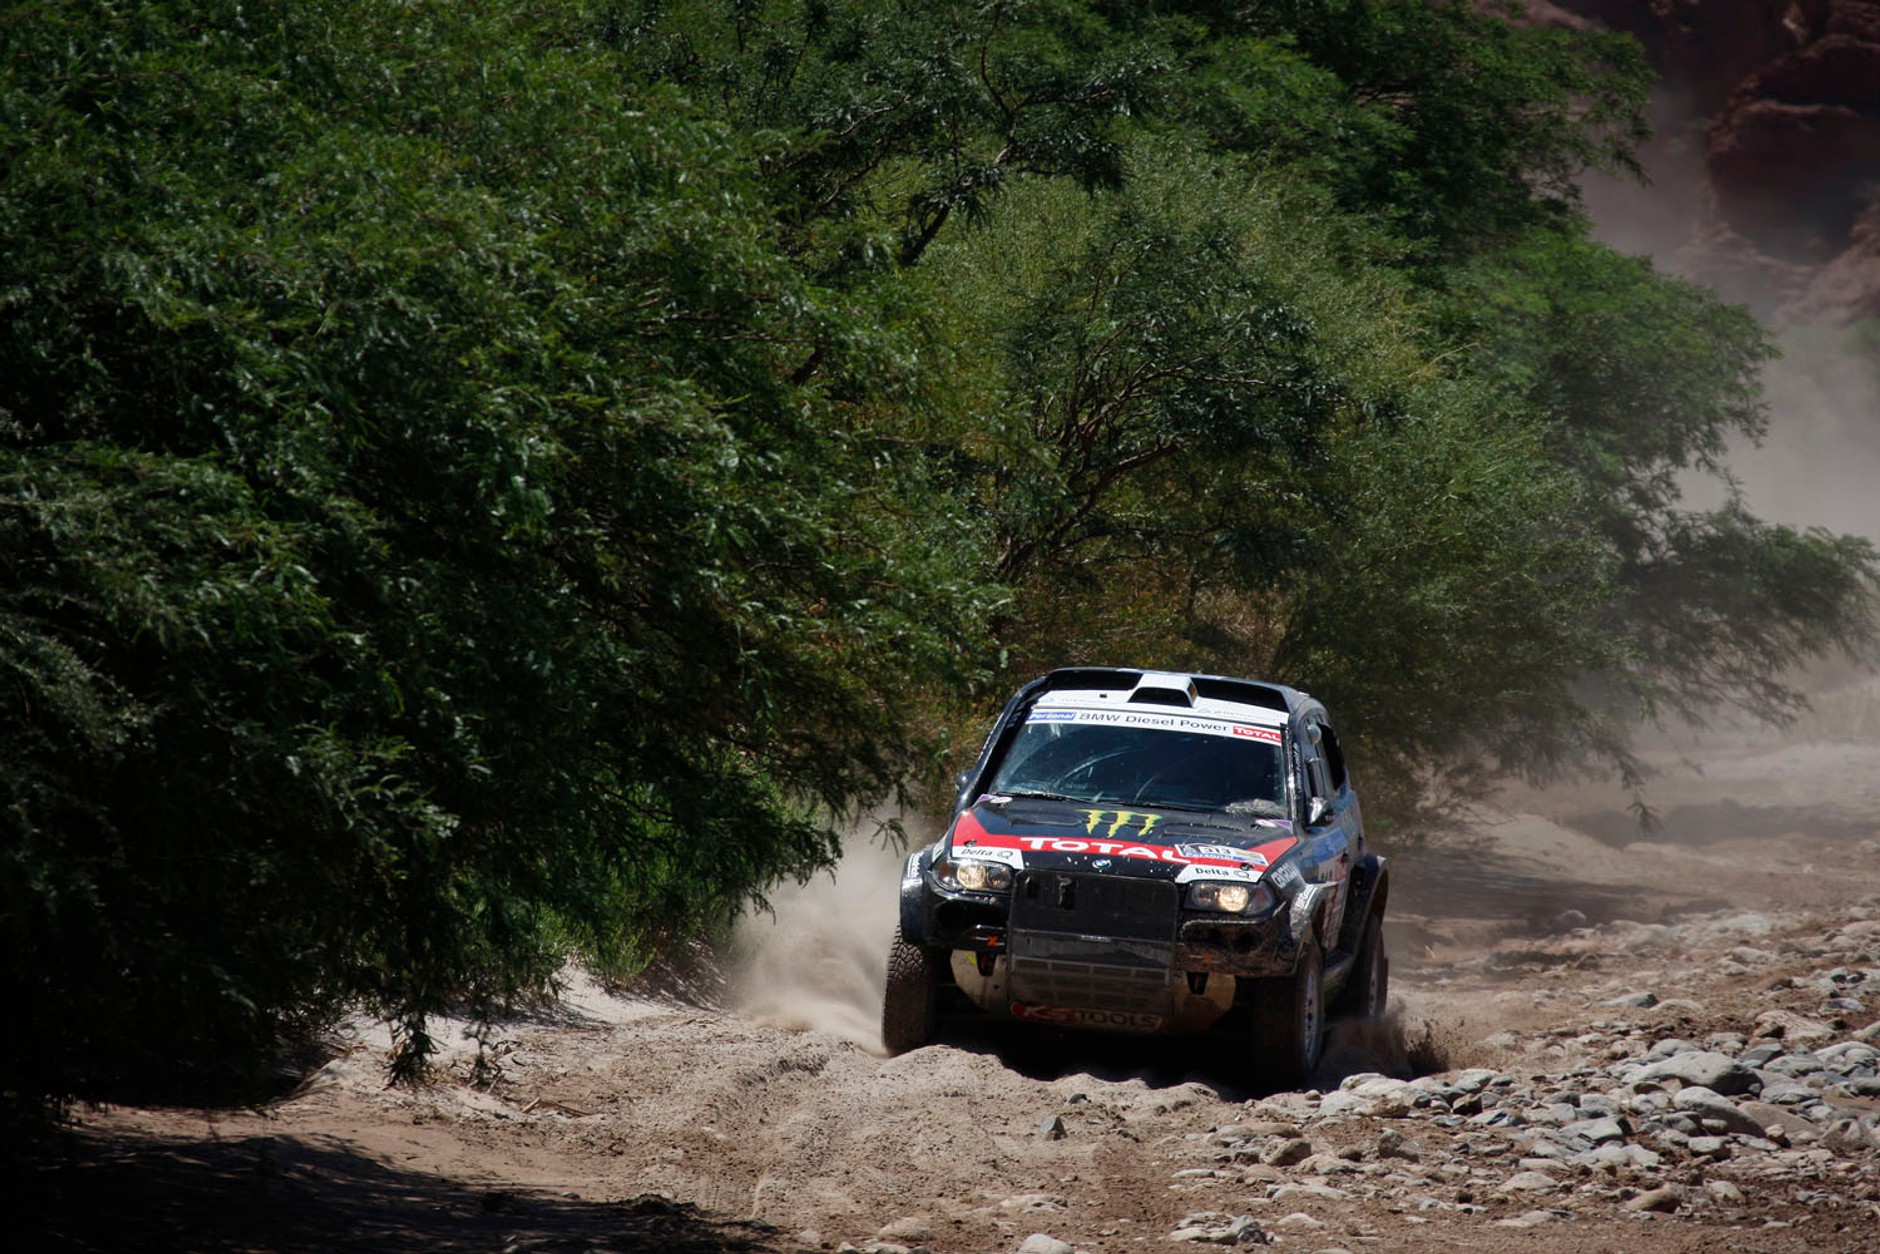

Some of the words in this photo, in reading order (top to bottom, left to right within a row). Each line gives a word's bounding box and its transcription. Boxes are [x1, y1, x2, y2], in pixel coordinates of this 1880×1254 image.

[1079, 712, 1121, 723] BMW
[1125, 715, 1174, 727] Diesel
[1180, 719, 1228, 732] Power
[1235, 727, 1280, 740] TOTAL
[961, 848, 993, 857] Delta
[1020, 837, 1191, 864] TOTAL
[1194, 867, 1230, 877] Delta
[1077, 1008, 1163, 1029] TOOLS
